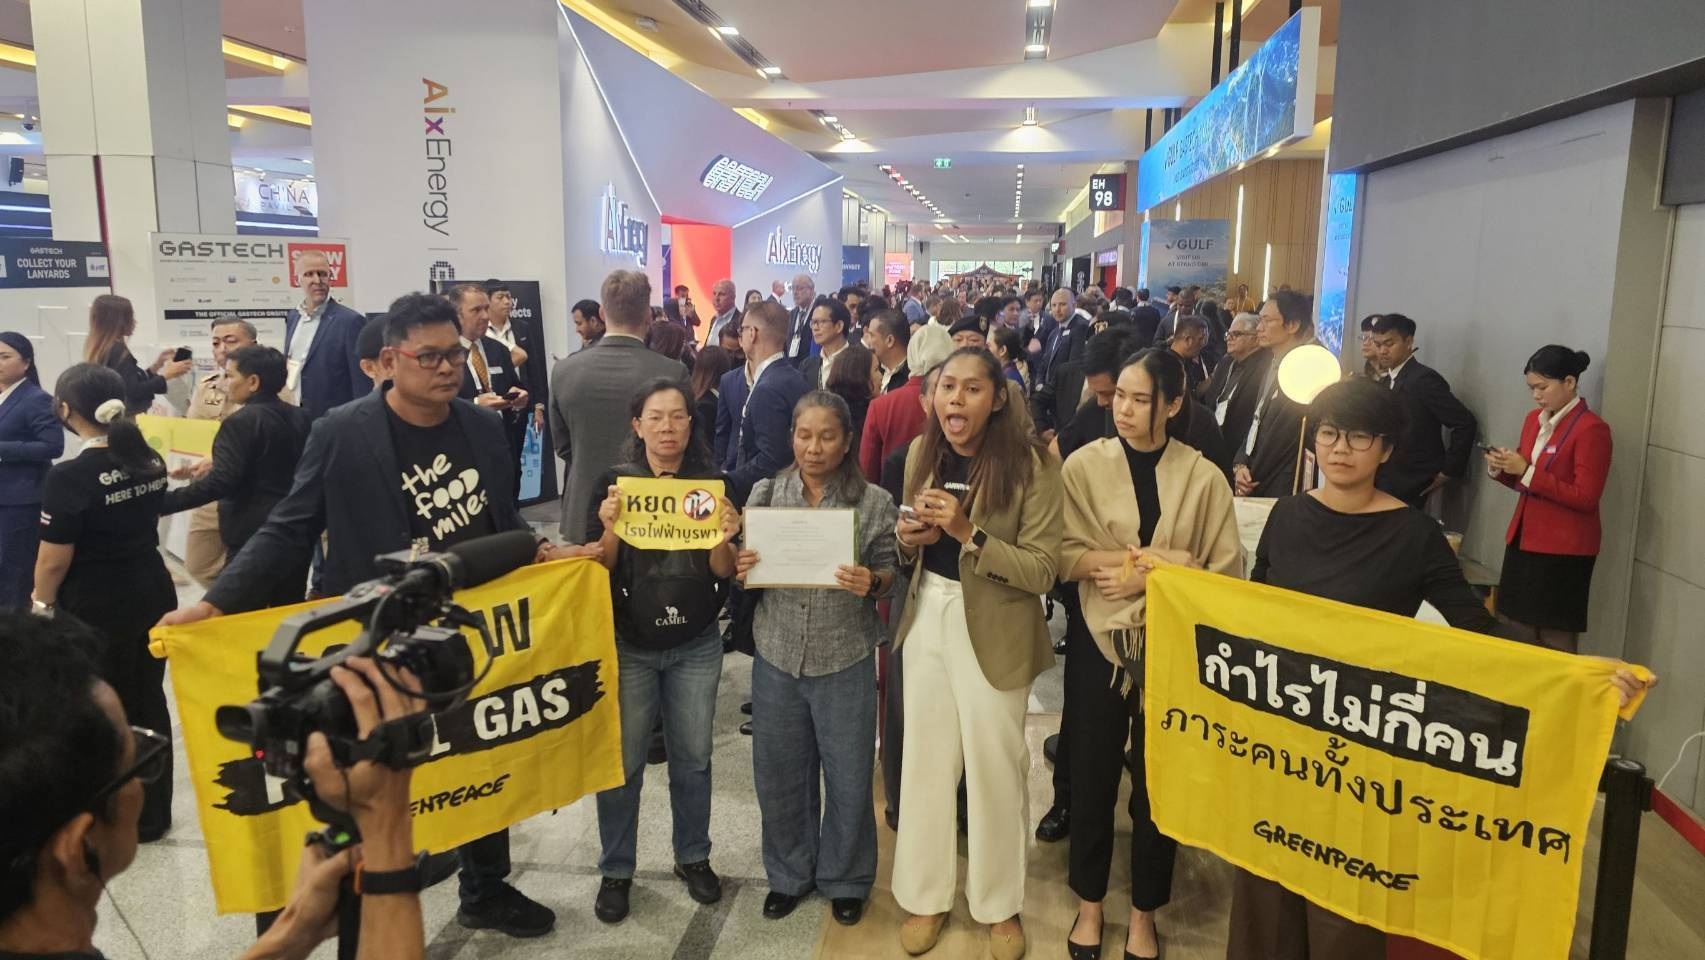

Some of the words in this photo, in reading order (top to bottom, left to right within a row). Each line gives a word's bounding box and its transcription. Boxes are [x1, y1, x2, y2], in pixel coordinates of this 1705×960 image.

[1092, 178, 1106, 190] EH
[1094, 190, 1113, 207] 98
[159, 240, 284, 258] GASTECH
[1177, 238, 1214, 250] GULF
[17, 258, 53, 269] COLLECT
[54, 258, 77, 269] YOUR
[27, 269, 71, 280] LANYARDS
[401, 453, 452, 496] the
[105, 487, 133, 505] HERE
[133, 484, 148, 497] TO
[625, 494, 677, 521] หยุด
[624, 521, 719, 544] โรงไฟฟ้าบูรพา
[655, 616, 688, 628] CAMEL
[473, 677, 570, 741] GAS
[1204, 641, 1518, 778] กำไรไม่กี่คน
[409, 773, 511, 817] ENPEACE
[1160, 706, 1571, 864] ภาระคนทั้งประเทศ
[1253, 820, 1419, 892] GREENPEACE
